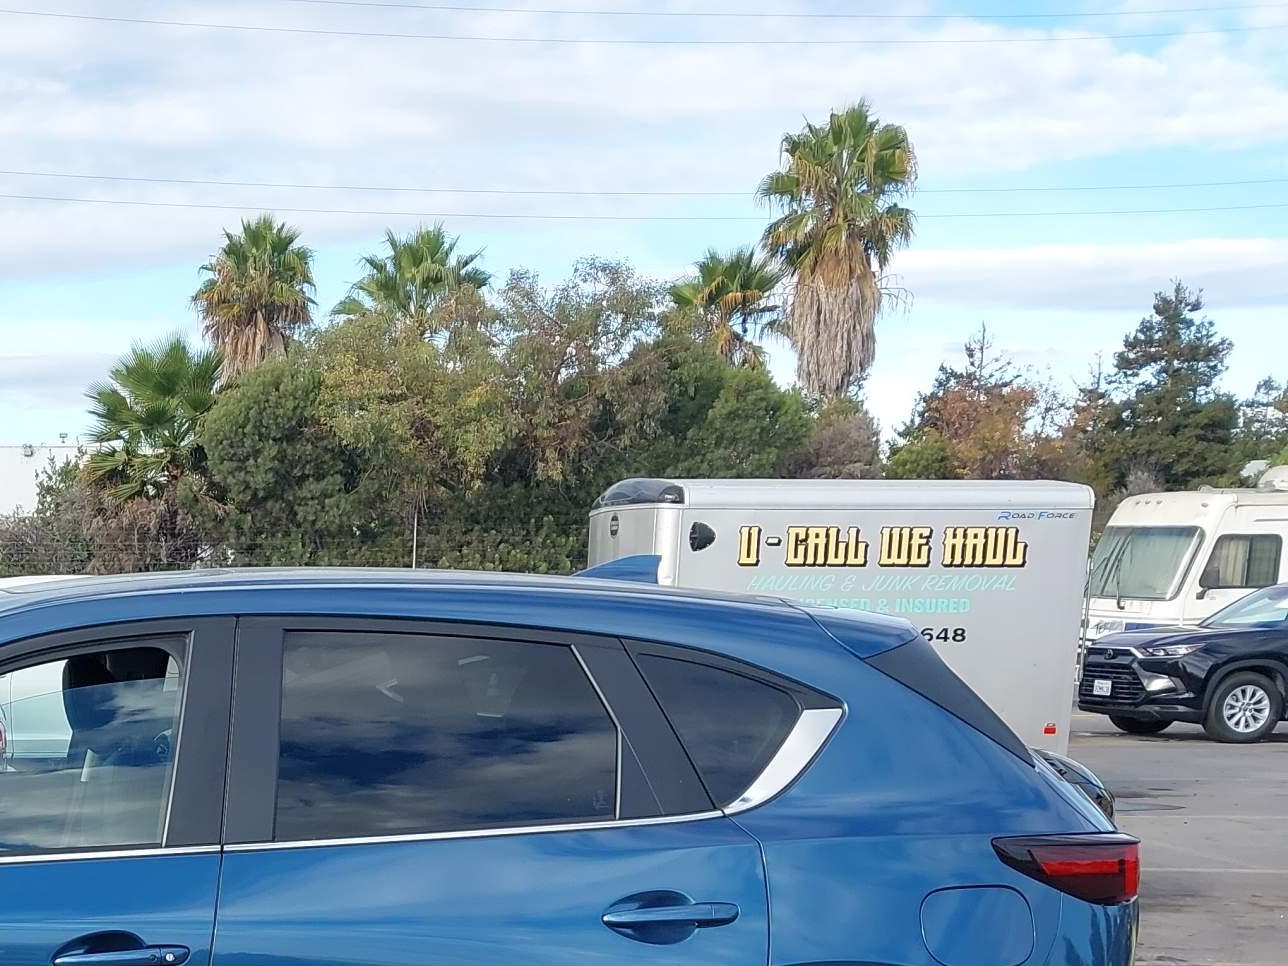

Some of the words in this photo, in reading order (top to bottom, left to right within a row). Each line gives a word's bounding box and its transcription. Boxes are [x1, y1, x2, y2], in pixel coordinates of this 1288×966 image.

[737, 525, 762, 567] U
[785, 525, 870, 567] CALL
[878, 526, 934, 568] WE
[941, 526, 1028, 568] HAUL
[746, 575, 836, 592] HAULING
[839, 575, 857, 592] &
[862, 575, 921, 592] JUNK
[921, 574, 1017, 592] REMOVAL
[895, 598, 970, 613] INSURED
